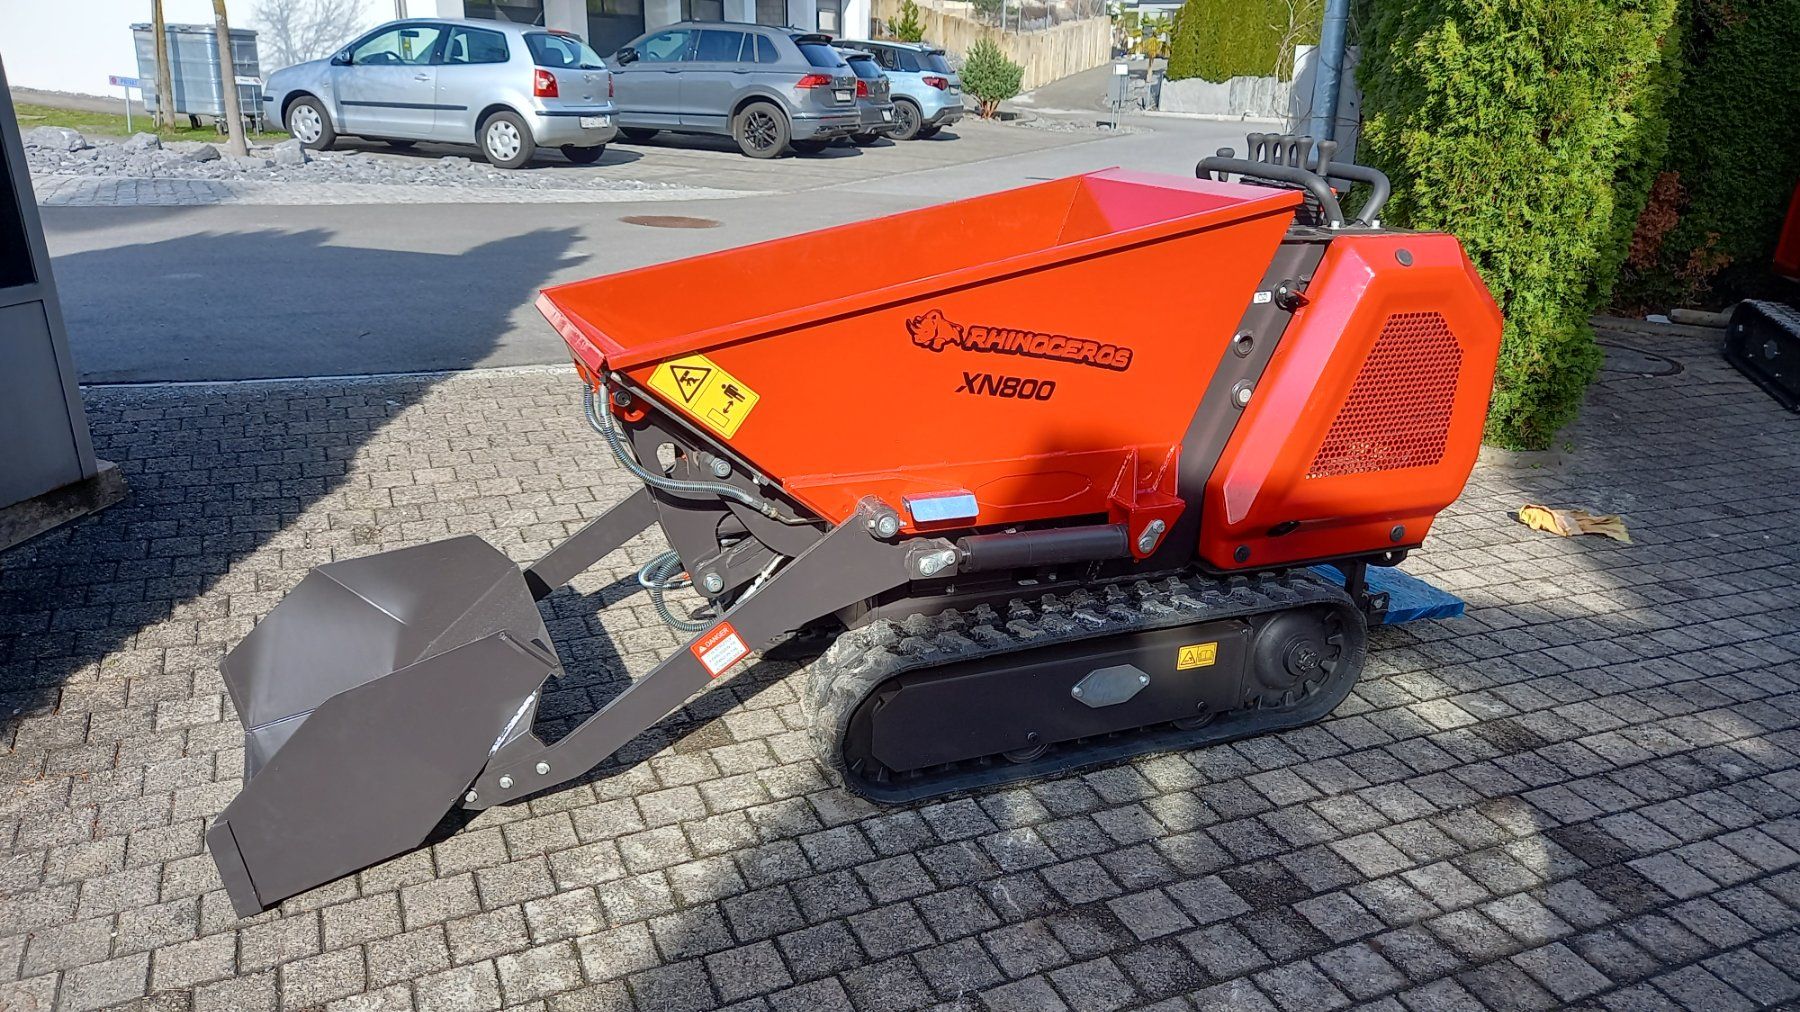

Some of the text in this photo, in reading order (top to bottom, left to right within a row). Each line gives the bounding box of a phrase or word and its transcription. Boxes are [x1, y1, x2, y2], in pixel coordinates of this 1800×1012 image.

[963, 325, 1133, 371] RHINOCEROS
[955, 372, 1056, 401] XN800
[705, 627, 729, 647] DANGER
